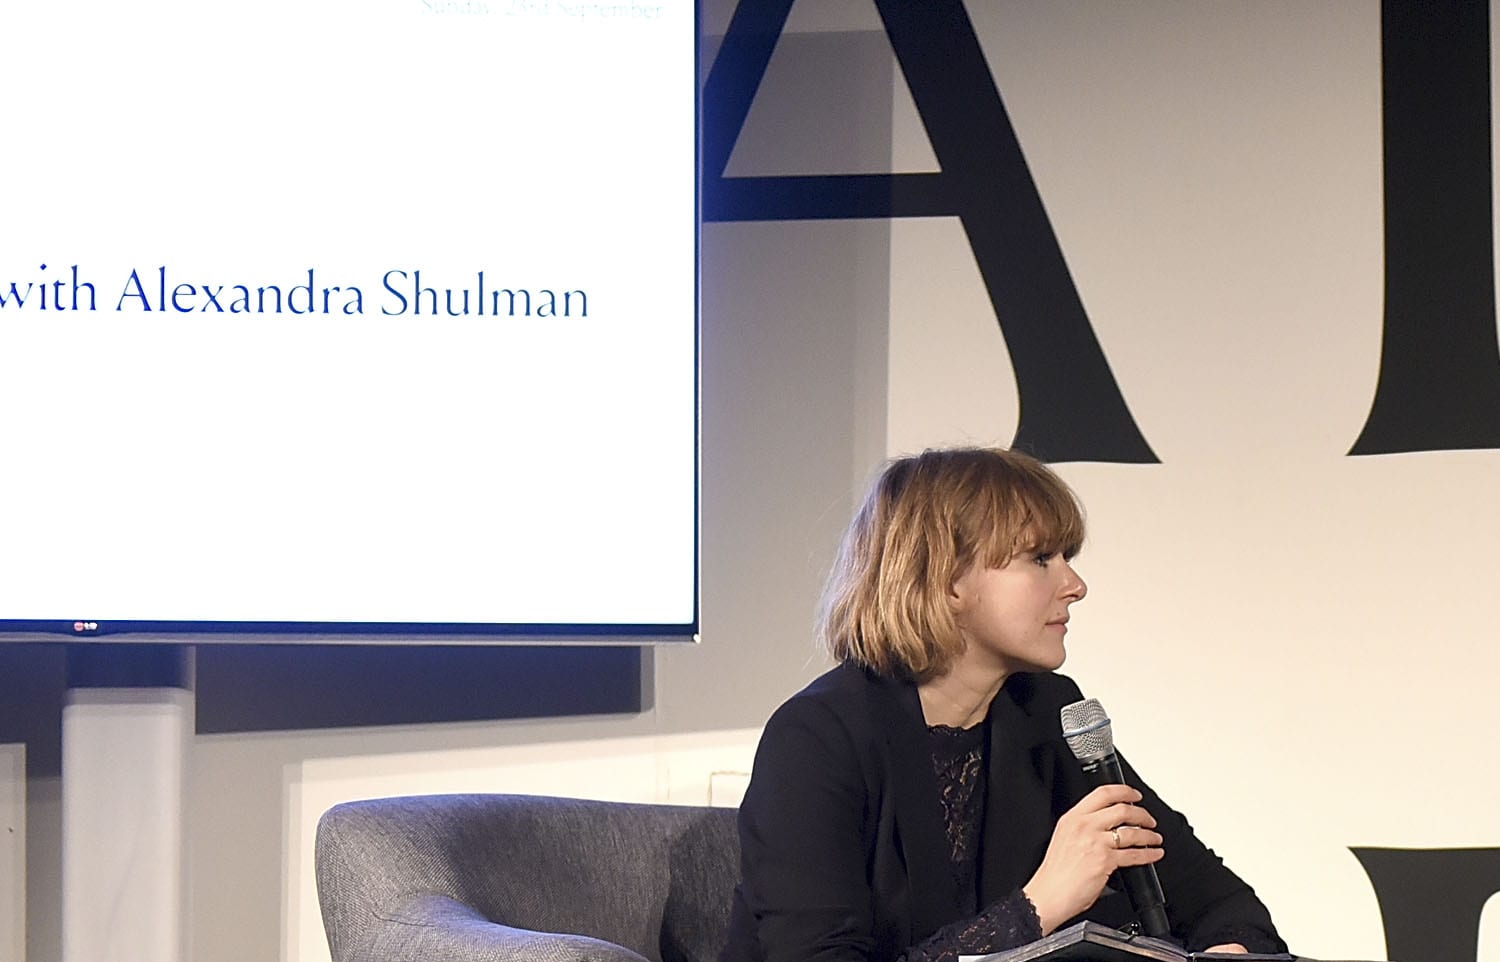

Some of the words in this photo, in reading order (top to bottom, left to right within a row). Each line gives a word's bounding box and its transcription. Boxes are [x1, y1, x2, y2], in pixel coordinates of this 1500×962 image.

[0, 263, 97, 312] with
[116, 265, 364, 316] Alexandra
[381, 269, 589, 319] Shulman
